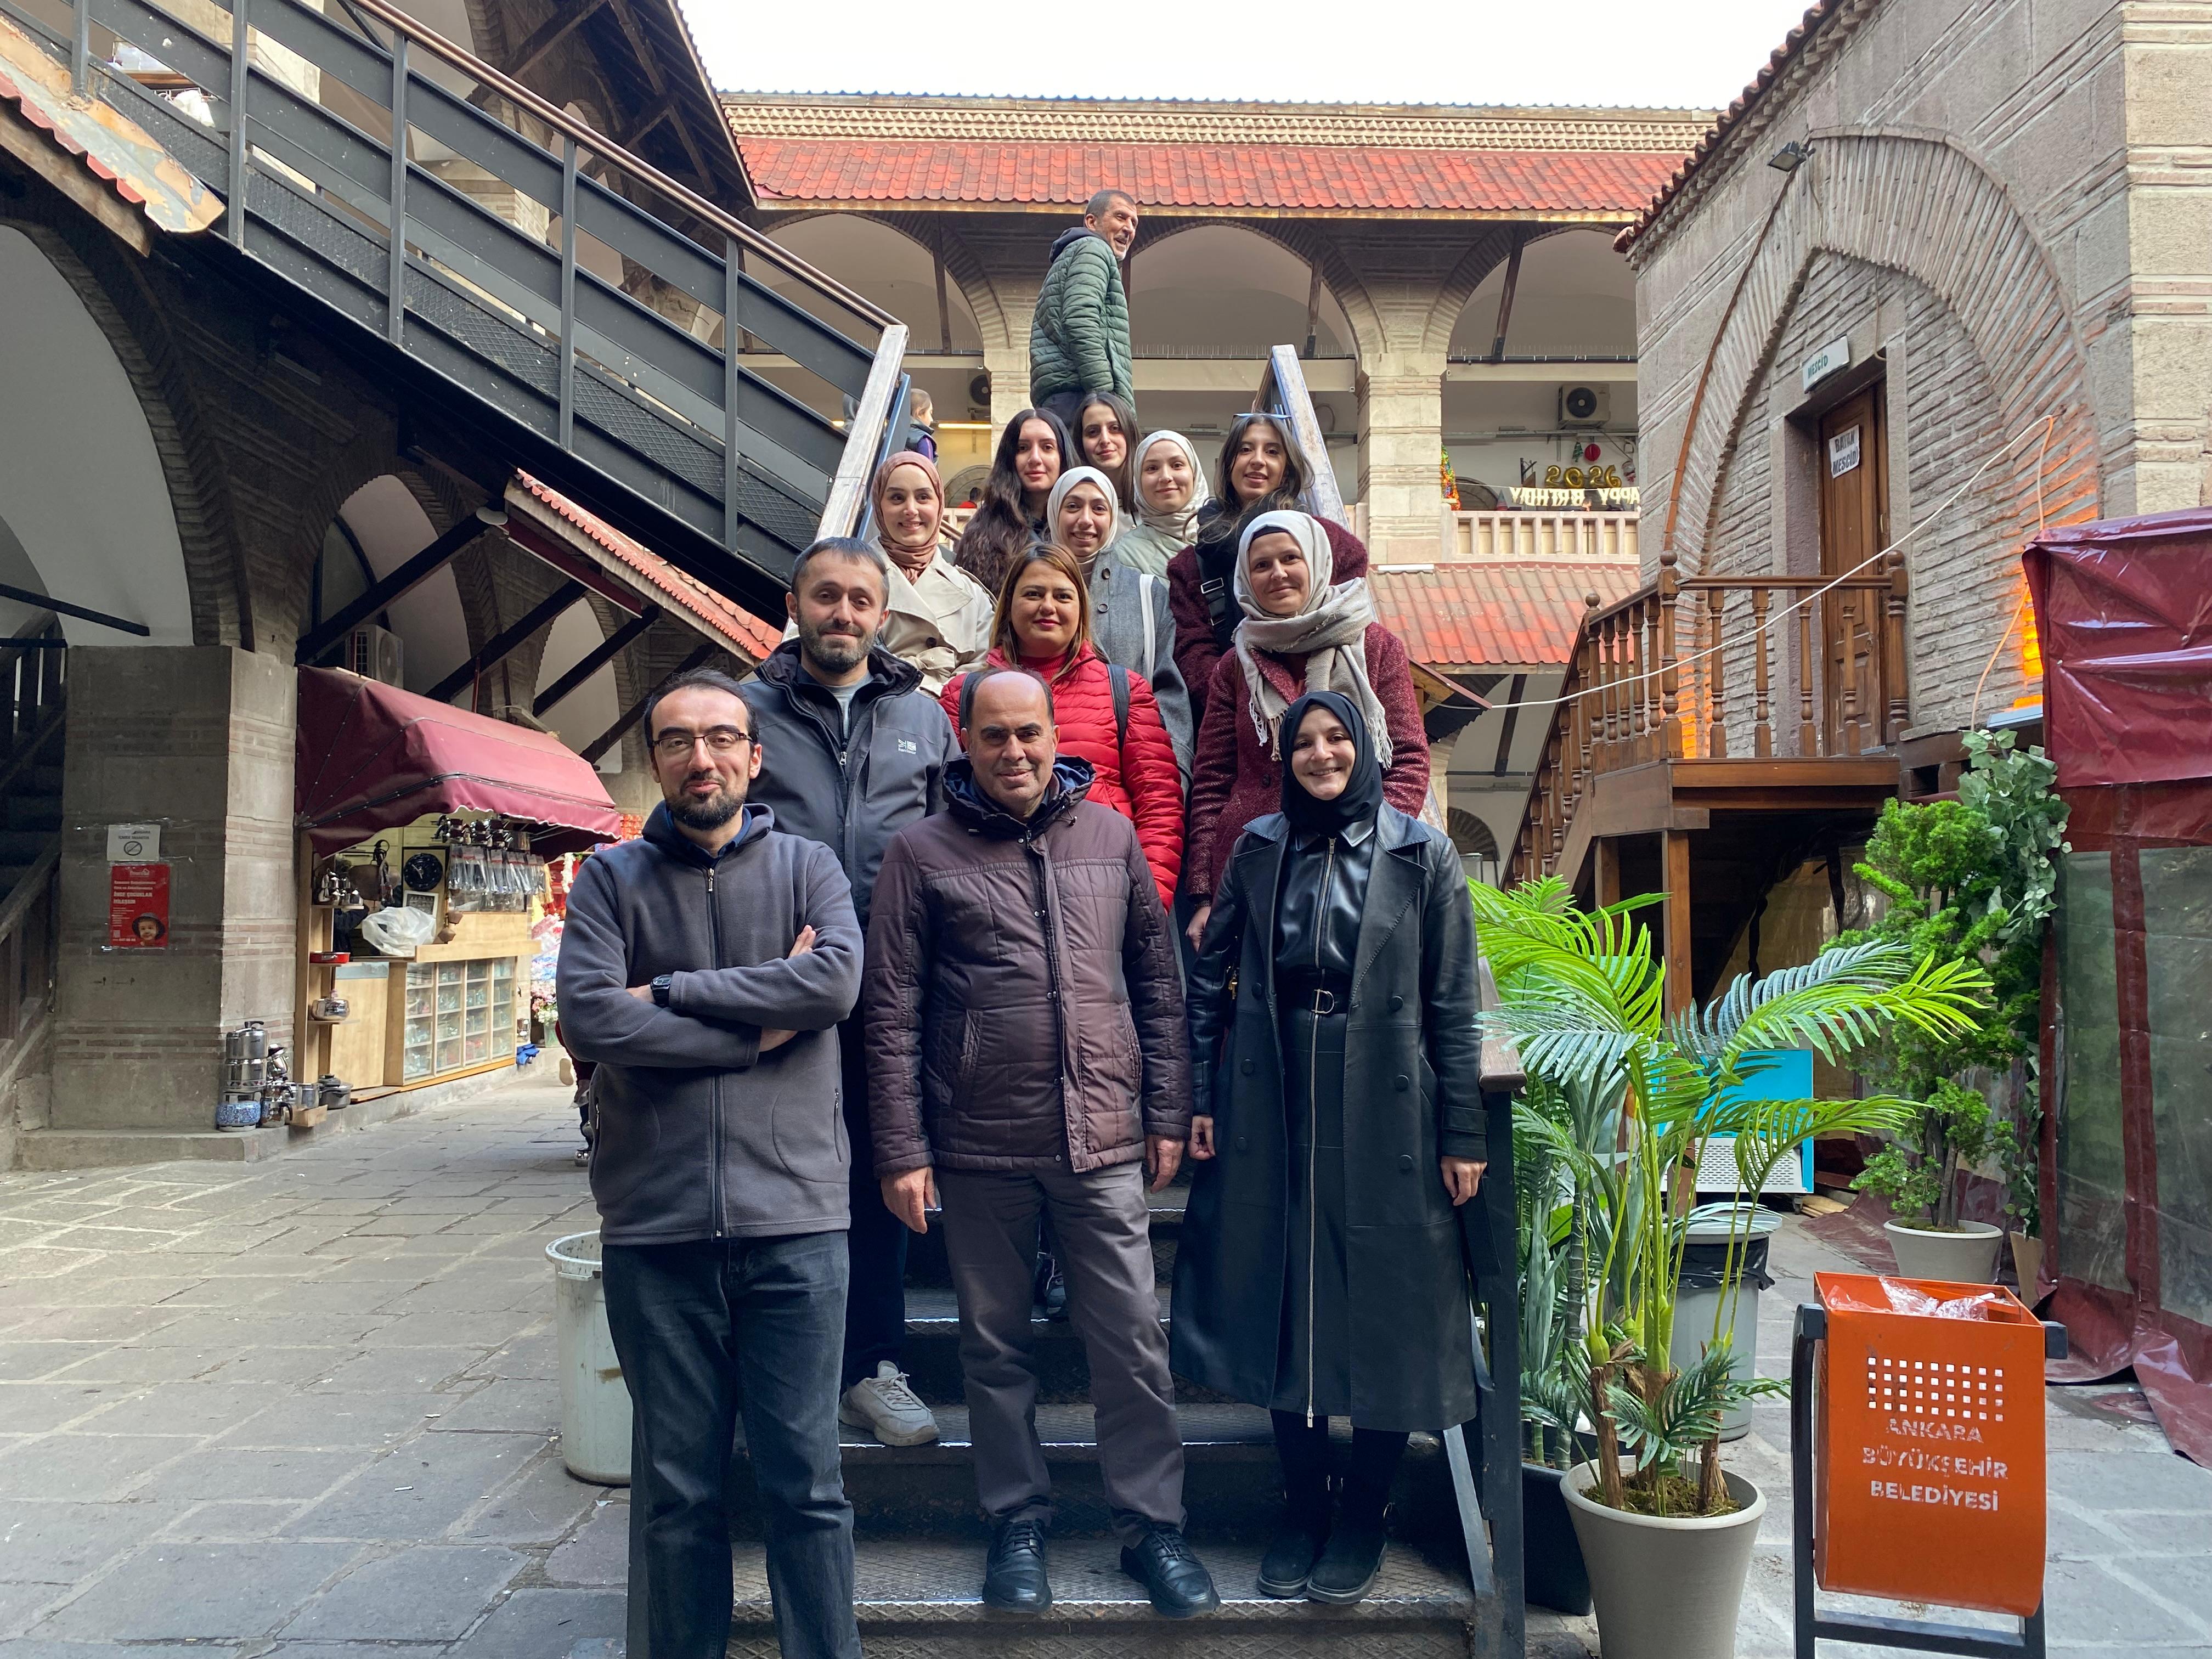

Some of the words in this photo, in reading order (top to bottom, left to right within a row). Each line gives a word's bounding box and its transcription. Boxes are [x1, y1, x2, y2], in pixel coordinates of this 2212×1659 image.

[1808, 353, 1829, 379] MESCİD
[1835, 430, 1855, 453] BAYAN
[1544, 465, 1622, 488] 2026
[1886, 1418, 1984, 1444] ANKARA
[1863, 1444, 2008, 1480] BÜYÜKŞEHİR
[1871, 1480, 1999, 1511] BELEDİYESİ
